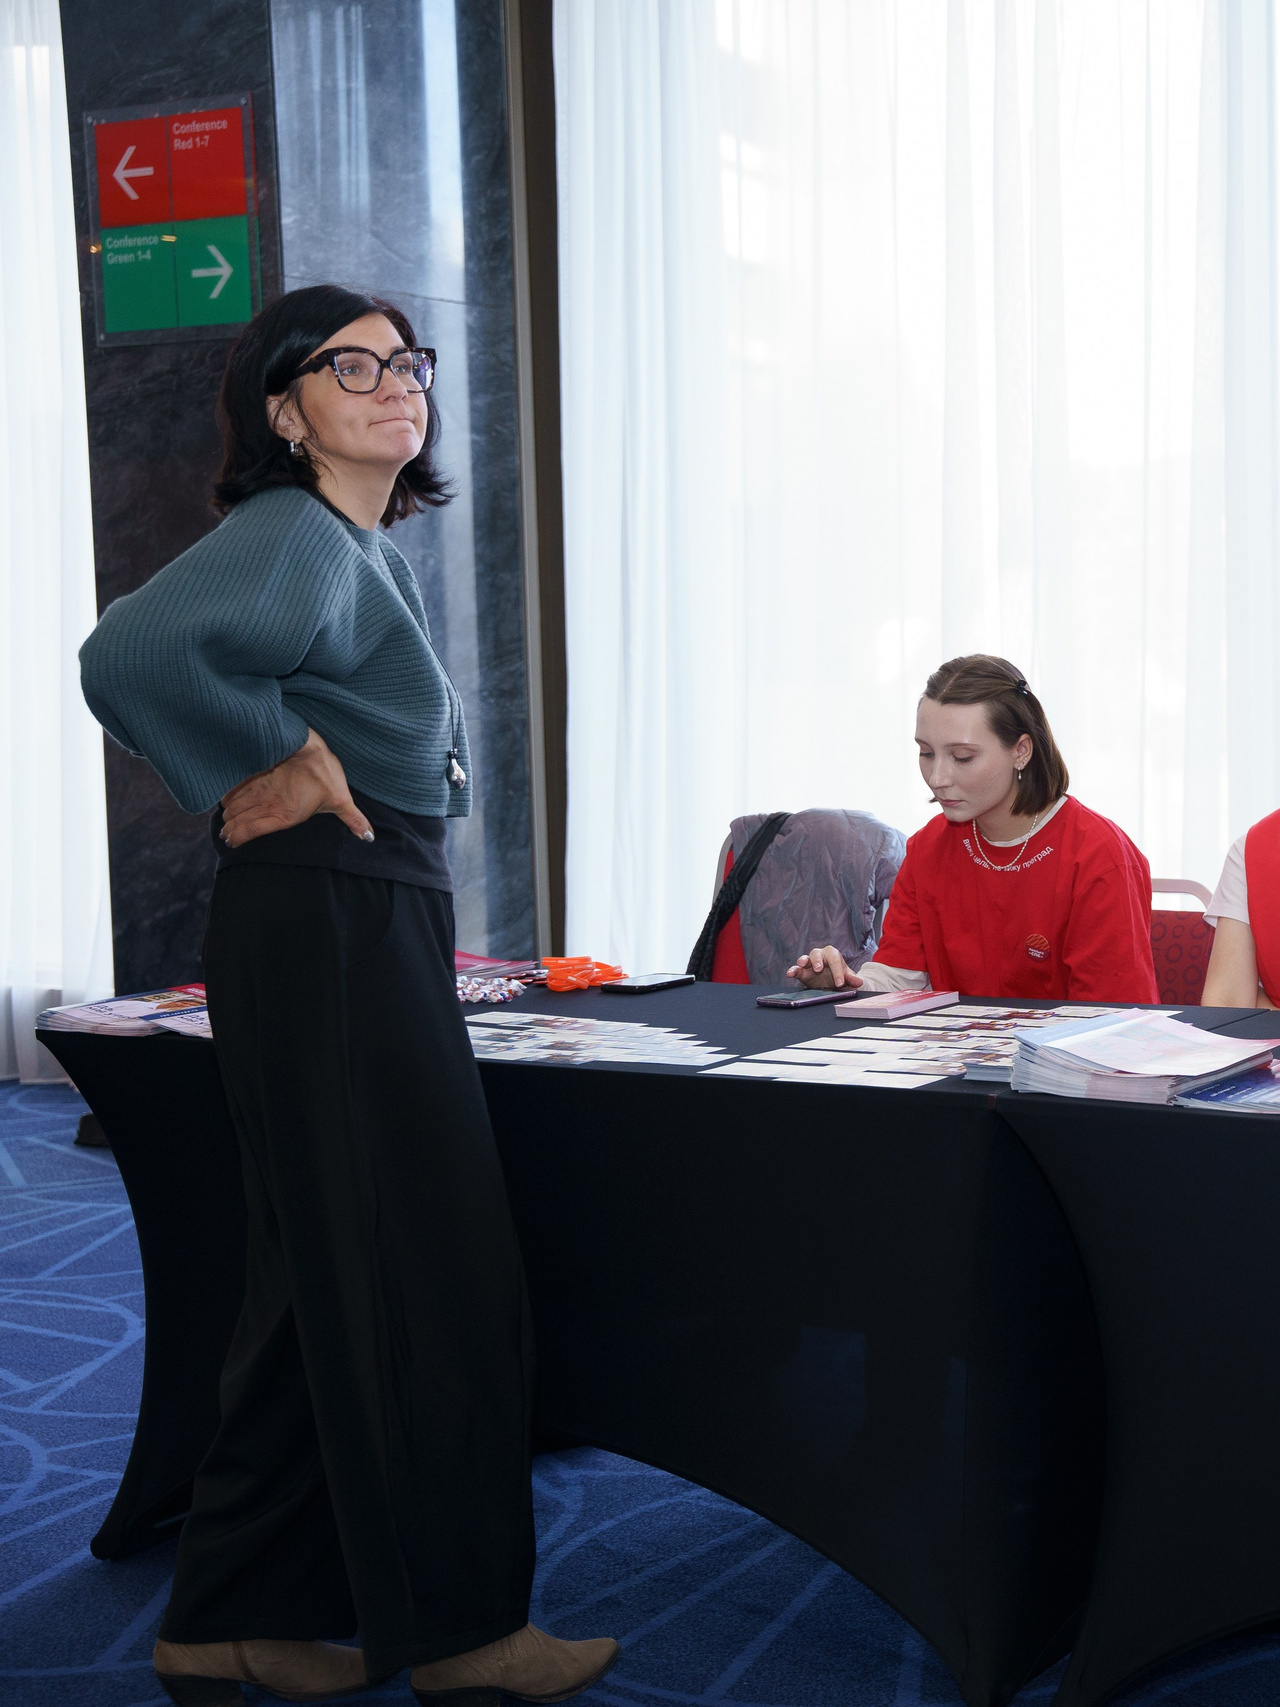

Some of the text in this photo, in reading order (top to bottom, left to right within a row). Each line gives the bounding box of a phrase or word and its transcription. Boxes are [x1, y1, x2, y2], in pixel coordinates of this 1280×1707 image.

[172, 119, 228, 135] Conference
[173, 135, 210, 150] Red 1-7
[105, 235, 159, 248] Conference
[107, 250, 152, 265] Green 1-4
[1022, 846, 1054, 869] преград
